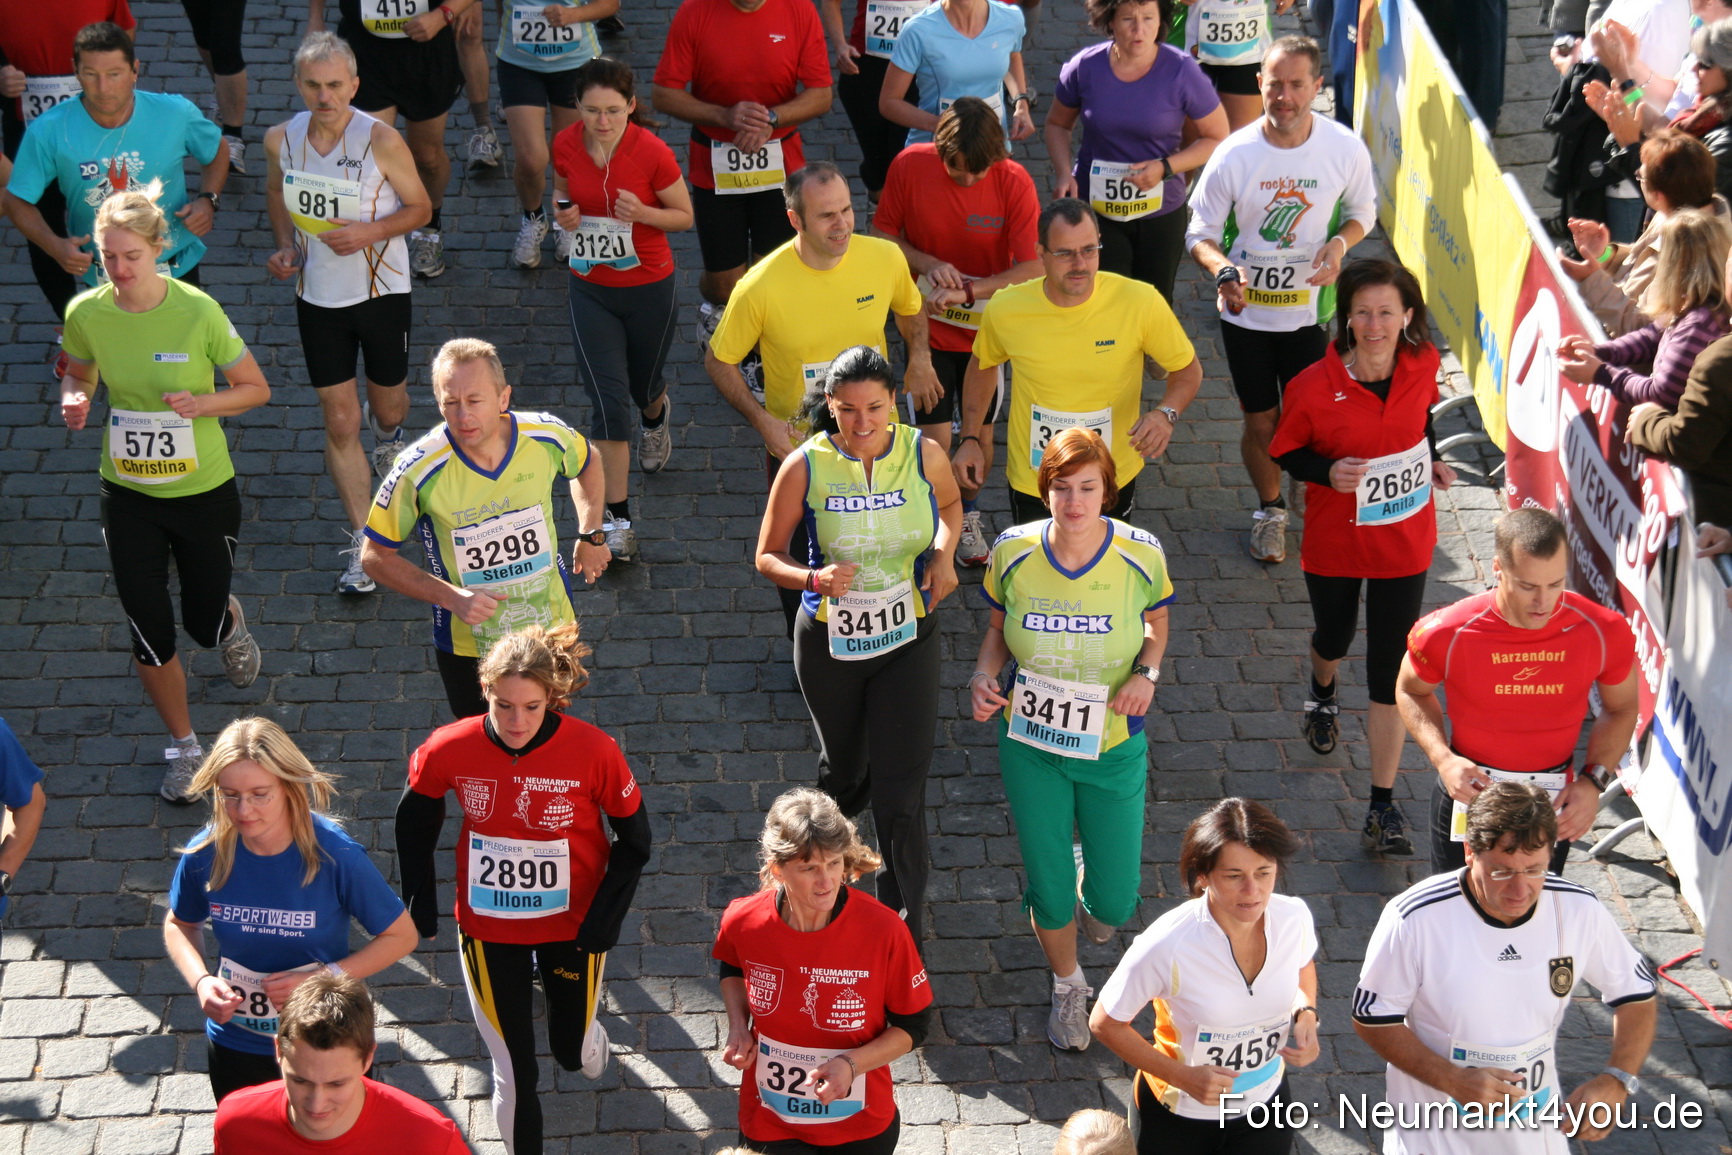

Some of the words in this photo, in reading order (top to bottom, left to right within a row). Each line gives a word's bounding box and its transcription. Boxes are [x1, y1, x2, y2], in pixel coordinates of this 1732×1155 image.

[377, 0, 416, 17] 415
[520, 22, 574, 42] 2215
[1207, 20, 1258, 43] 3533
[534, 44, 563, 55] Anita
[878, 39, 894, 51] An
[29, 94, 71, 118] 32
[728, 147, 768, 171] 938
[80, 163, 99, 176] 20
[294, 176, 326, 189] PFLEIDERER
[734, 174, 759, 188] Udo
[1297, 179, 1318, 189] run
[298, 190, 339, 219] 981
[1105, 202, 1148, 216] Regina
[575, 232, 626, 259] 3120
[1250, 266, 1295, 290] 762
[856, 294, 875, 303] KANN
[1247, 289, 1298, 304] Thomas
[120, 417, 152, 426] PFLEIDERER
[1042, 413, 1077, 425] PFLEIDERER
[125, 431, 176, 457] 573
[121, 459, 187, 475] Christina
[826, 482, 878, 494] TEAM
[1366, 461, 1425, 504] 2682
[826, 489, 907, 512] BOCK
[1382, 496, 1415, 516] Anita
[452, 496, 510, 524] TEAM
[465, 525, 504, 543] PFLEIDERER
[465, 529, 540, 570] 3298
[482, 561, 533, 581] Stefan
[840, 596, 878, 606] PFLEIDERER
[1029, 597, 1082, 612] TEAM
[838, 601, 906, 636] 3410
[1024, 613, 1112, 633] BOCK
[846, 630, 902, 652] Claudia
[1492, 650, 1566, 664] Harzendorf
[1027, 676, 1065, 694] PFLEIDERER
[1495, 684, 1564, 695] GERMANY
[1021, 689, 1091, 731] 3411
[1026, 720, 1081, 748] Miriam
[462, 783, 489, 793] IMMER
[513, 776, 524, 784] 11.
[525, 777, 580, 788] NEUMARKTER
[523, 783, 569, 794] STADTLAUF
[463, 788, 490, 800] WIEDER
[464, 795, 487, 811] NEU
[483, 840, 522, 854] PFLEIDERER
[480, 855, 558, 889] 2890
[494, 890, 542, 908] Illona
[222, 907, 313, 928] SPORTWEISS
[242, 925, 256, 933] Wir
[258, 927, 277, 935] sind
[278, 928, 305, 938] Sport.
[750, 969, 776, 981] IMMER
[799, 966, 811, 974] 11.
[812, 967, 869, 978] NEUMARKTER
[810, 975, 858, 985] STADTLAUF
[750, 975, 777, 991] WIEDER
[749, 984, 774, 1001] NEU
[750, 996, 772, 1010] MARKT
[830, 1010, 866, 1018] 19.09.2010
[1213, 1027, 1256, 1040] PFLEIDERER
[771, 1046, 816, 1062] PFLEIDERER
[1203, 1032, 1280, 1071] 3458
[1467, 1050, 1517, 1062] PFLEIDERER
[787, 1097, 829, 1114] Gabi
